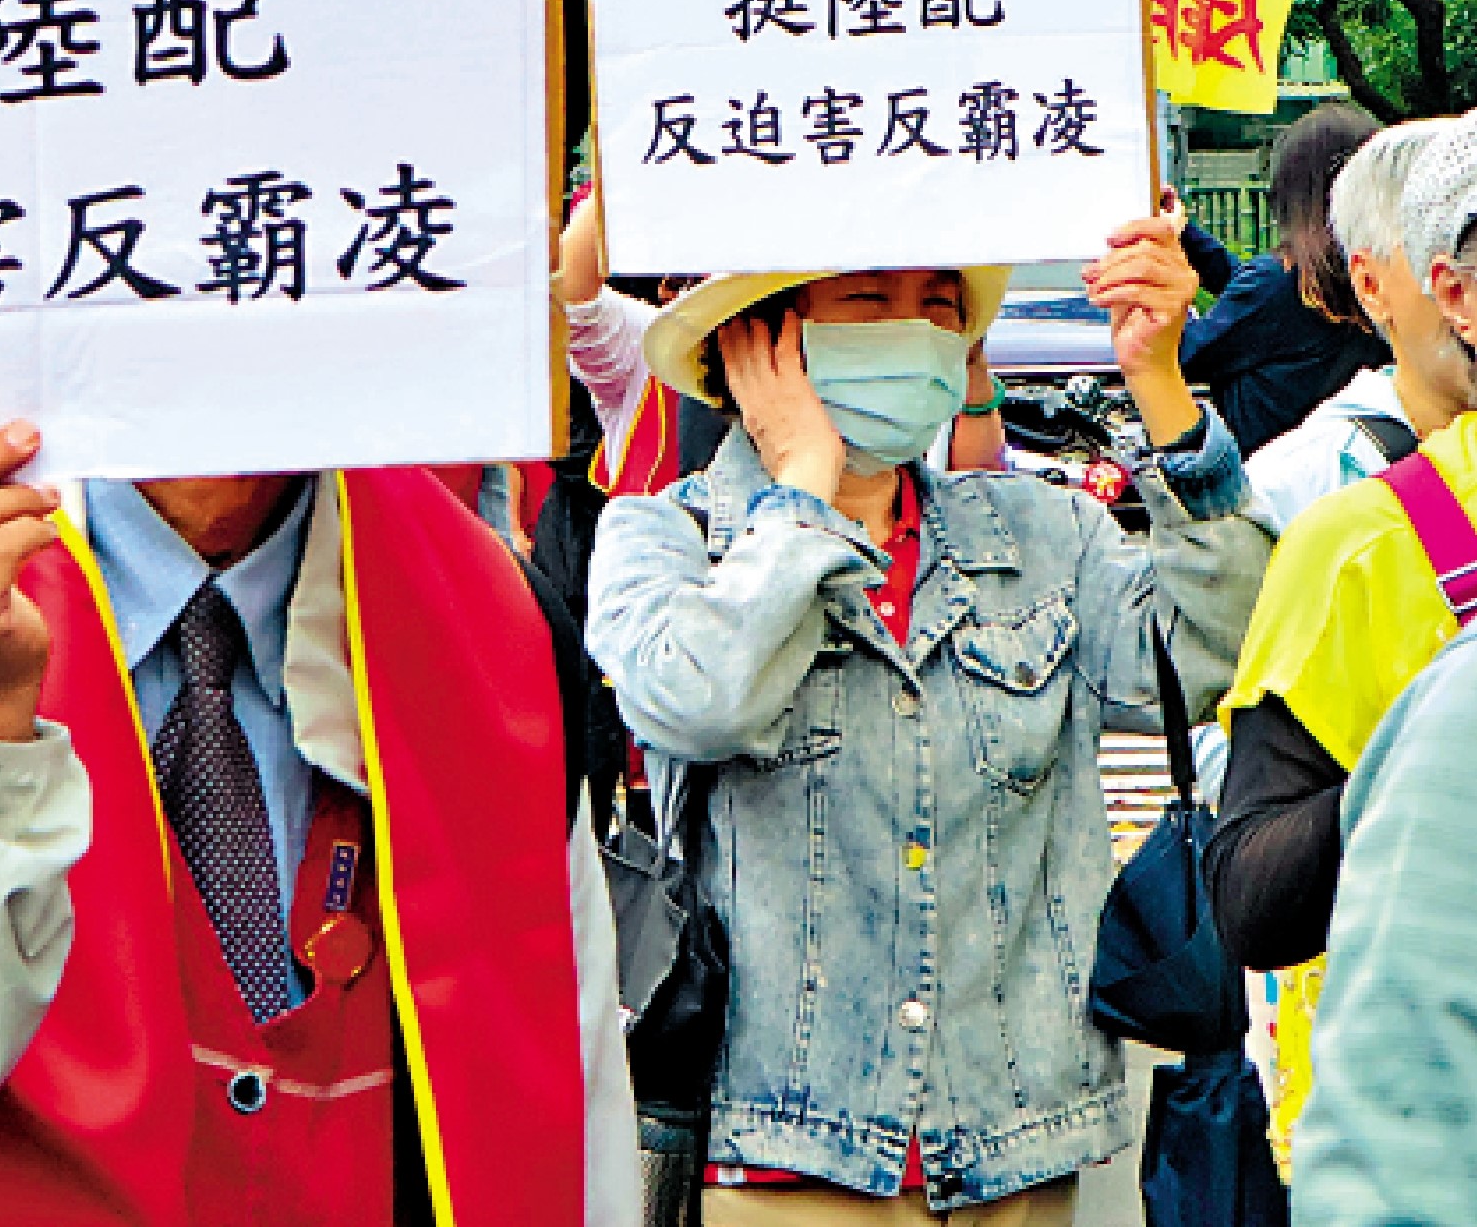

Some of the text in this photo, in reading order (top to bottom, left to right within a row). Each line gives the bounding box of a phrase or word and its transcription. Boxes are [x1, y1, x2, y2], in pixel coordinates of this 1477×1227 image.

[643, 78, 1106, 165] 反迫害反霸凌
